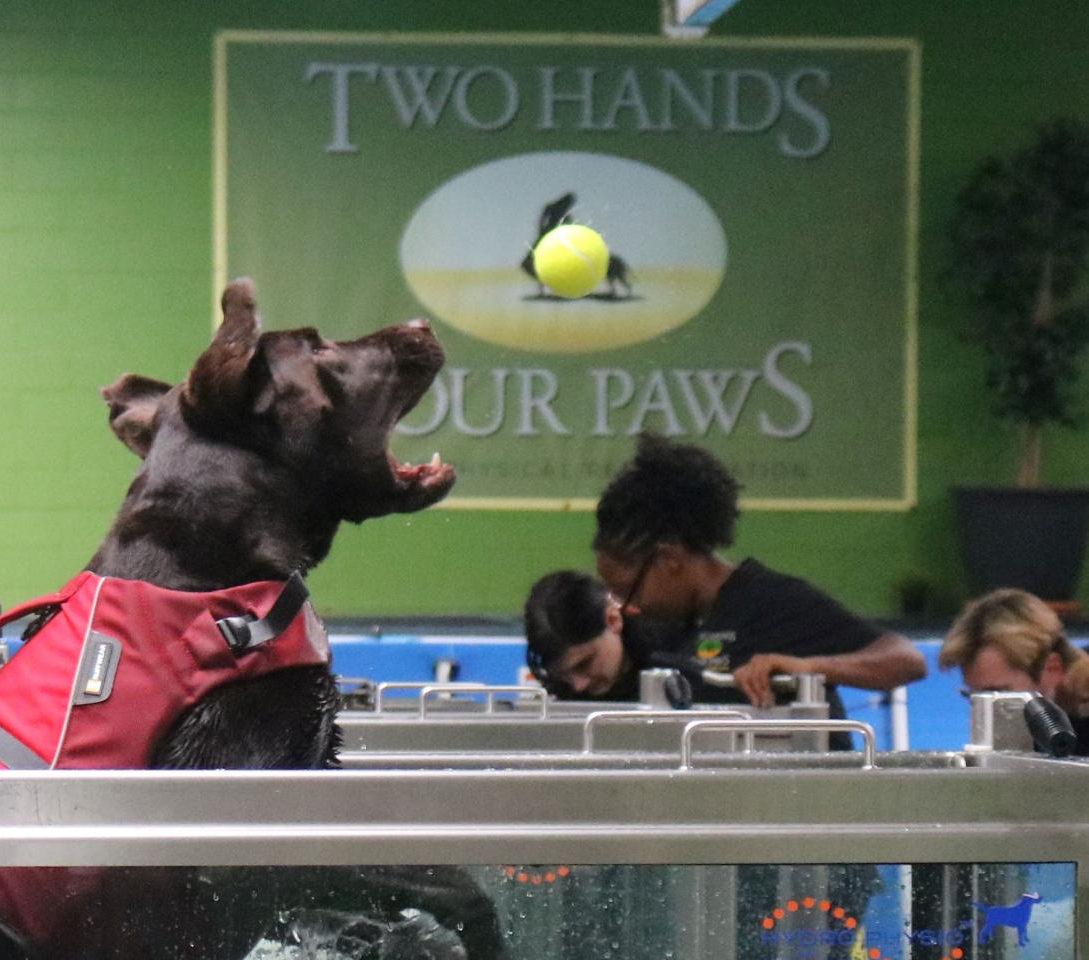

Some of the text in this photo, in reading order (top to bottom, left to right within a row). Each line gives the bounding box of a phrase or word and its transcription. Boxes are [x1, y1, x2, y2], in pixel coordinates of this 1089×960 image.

[304, 62, 831, 158] TWO HANDS
[394, 341, 813, 439] OUR PAWS
